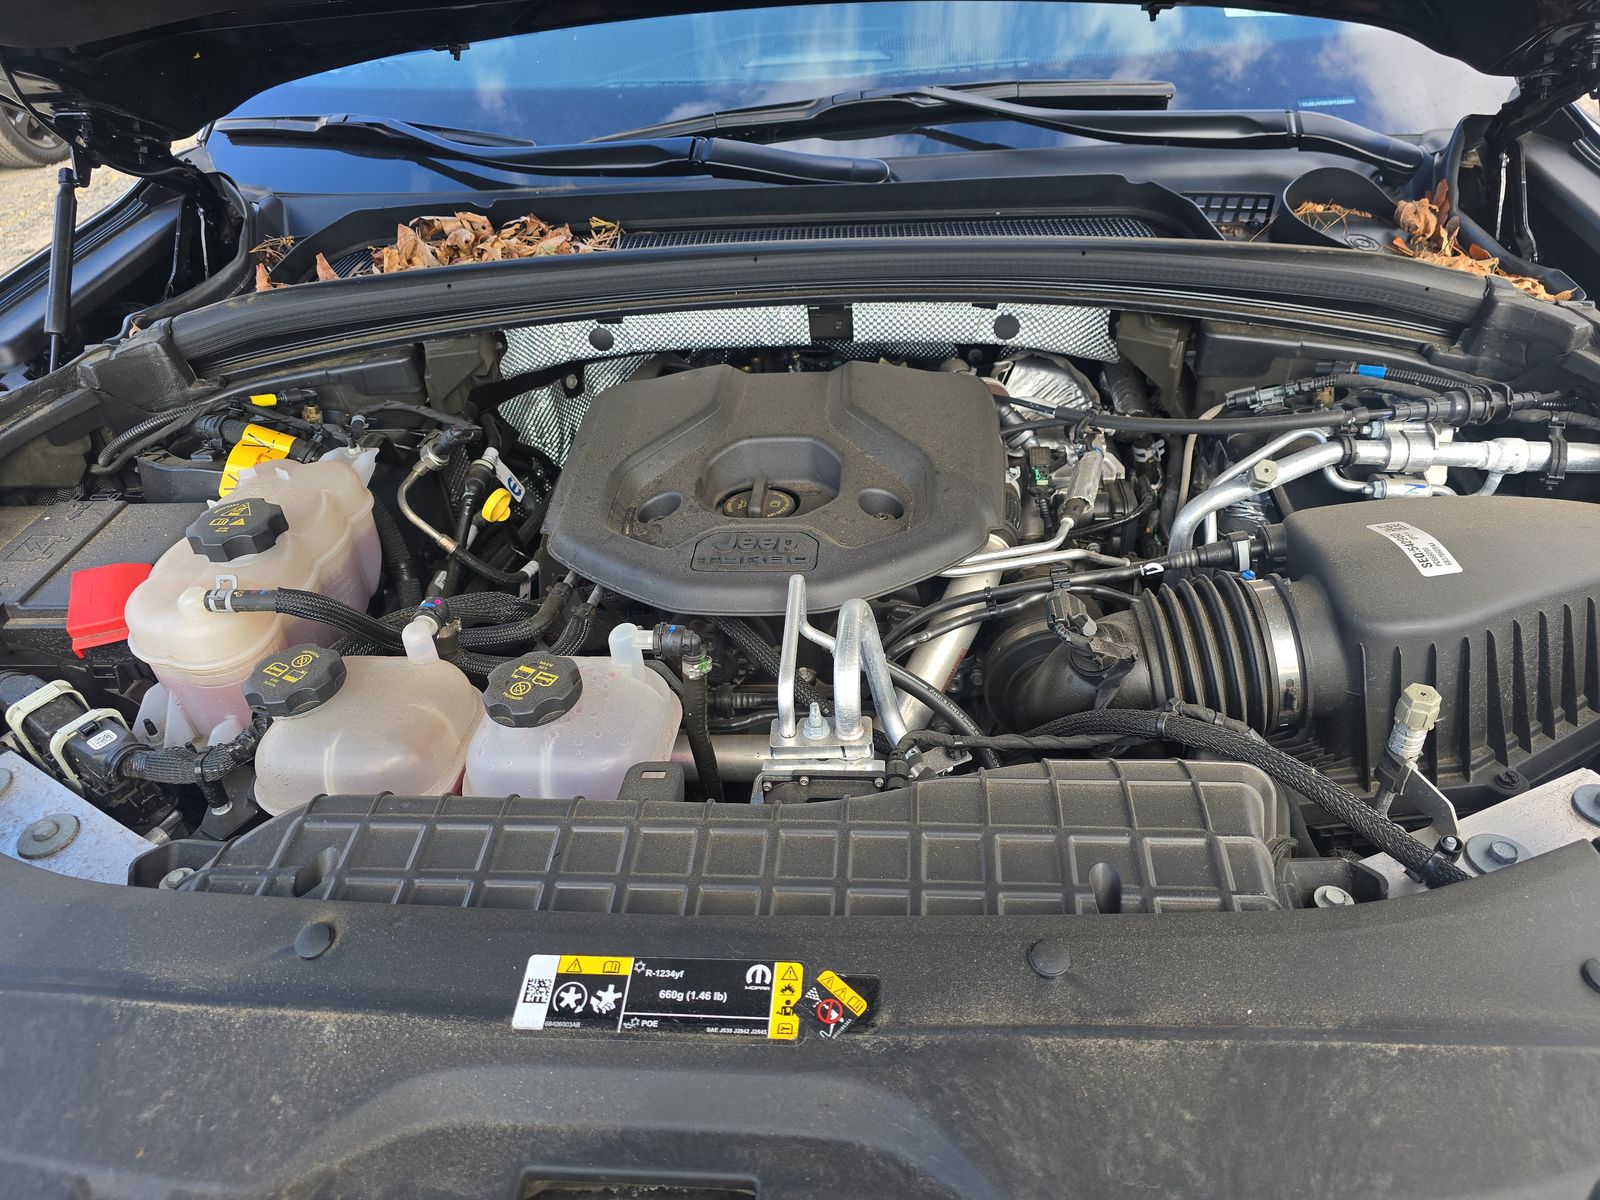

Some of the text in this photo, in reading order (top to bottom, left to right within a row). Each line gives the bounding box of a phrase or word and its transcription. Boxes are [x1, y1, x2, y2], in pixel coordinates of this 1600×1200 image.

[714, 533, 799, 555] Jeep
[697, 555, 811, 565] TURBO
[645, 969, 685, 980] R-1234yf
[659, 990, 728, 1003] 660g (1.46 lb)
[641, 1019, 659, 1028] POE
